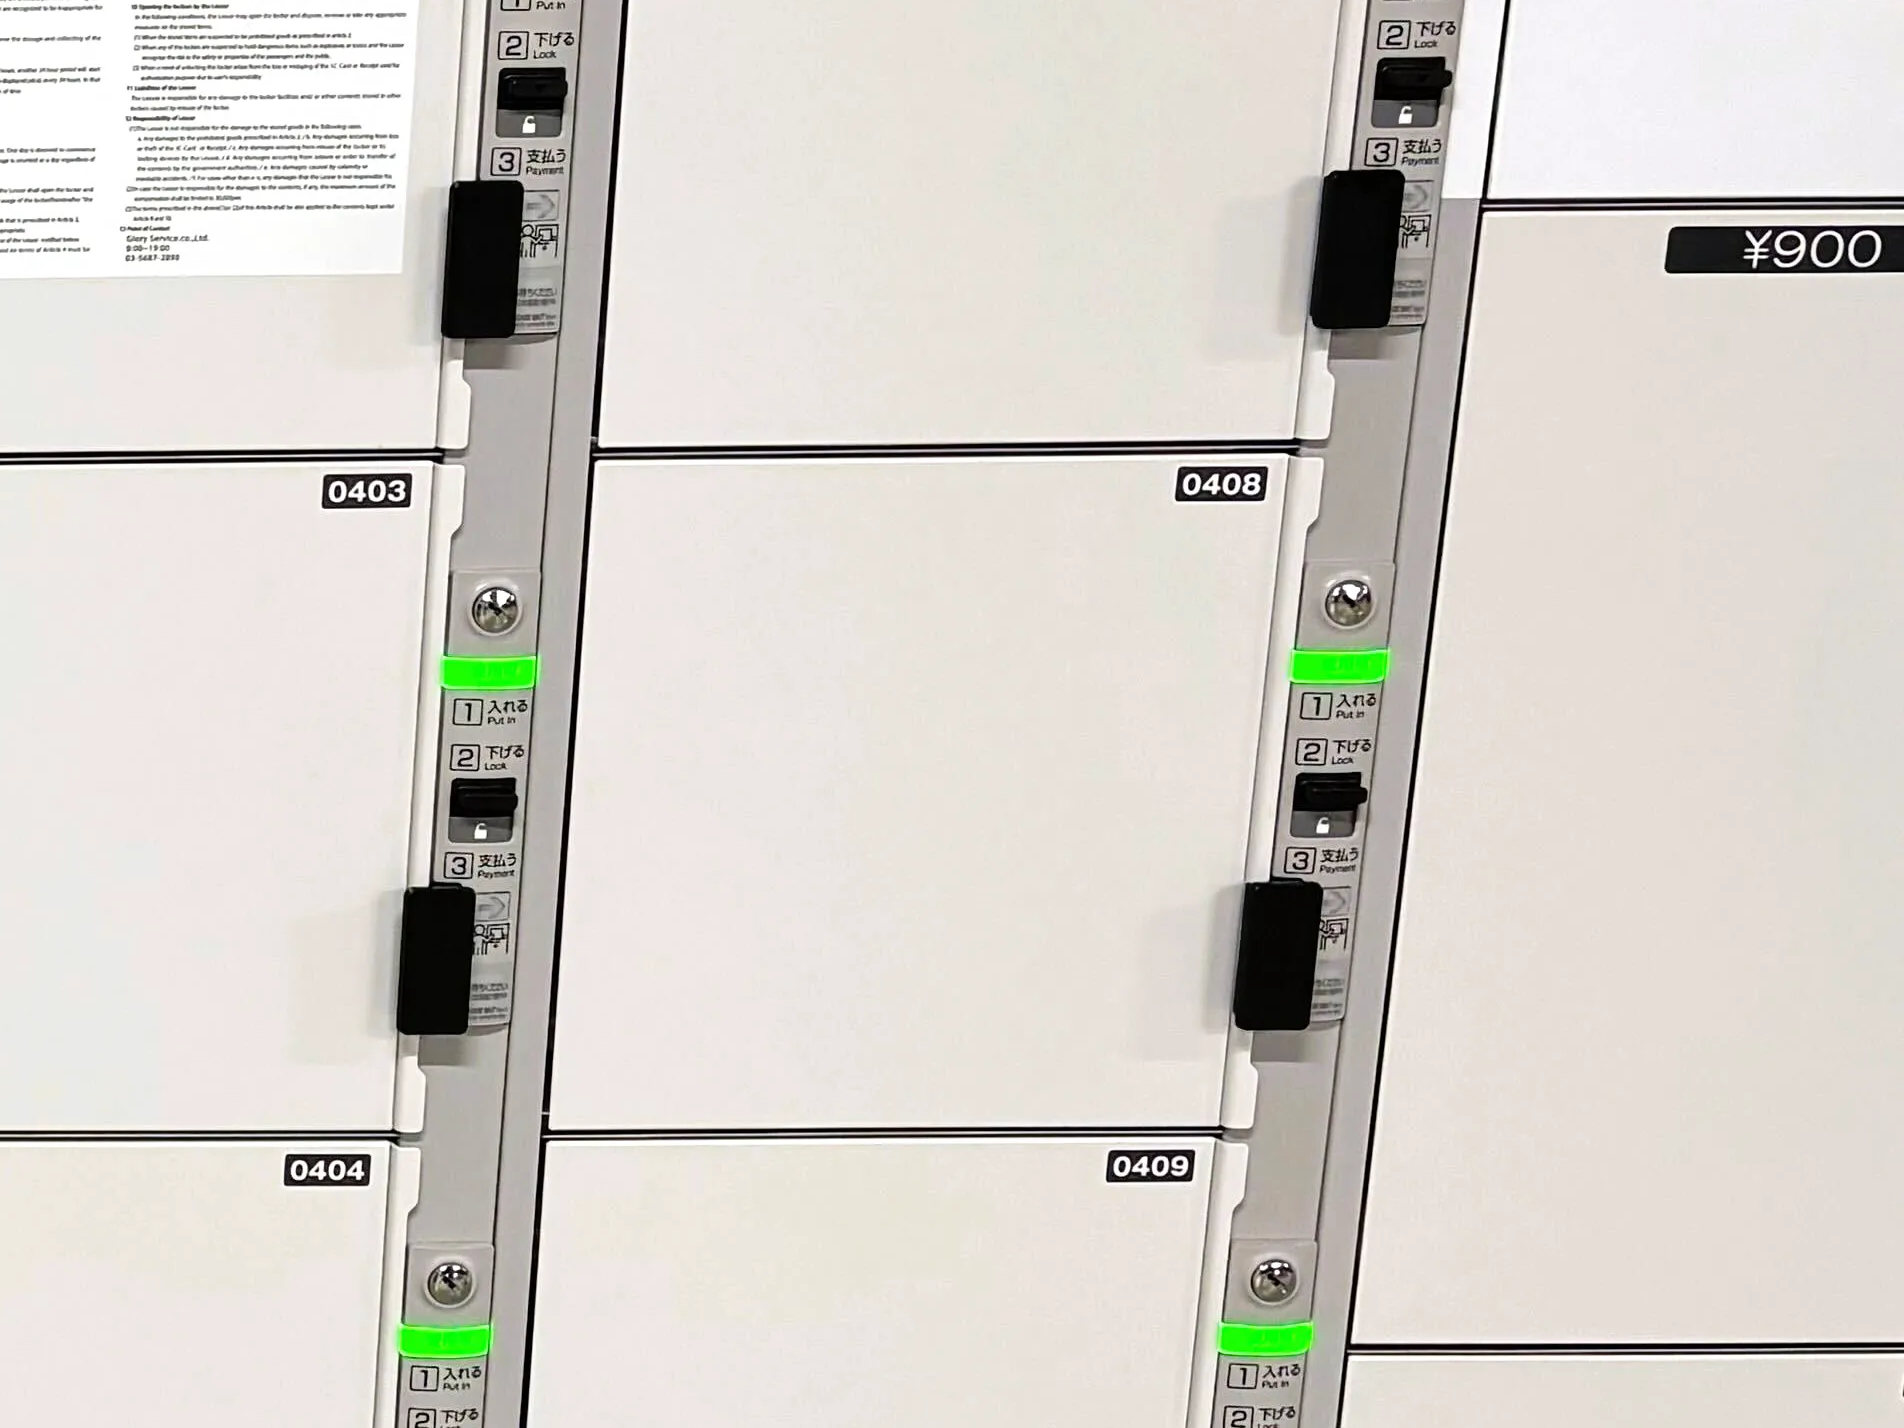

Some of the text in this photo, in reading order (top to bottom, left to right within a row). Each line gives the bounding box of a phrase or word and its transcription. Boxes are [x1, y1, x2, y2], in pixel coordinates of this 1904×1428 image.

[1743, 229, 1882, 269] ¥900
[328, 479, 406, 503] 0403
[1182, 472, 1261, 496] 0408
[290, 1159, 365, 1181] 0404
[1113, 1155, 1189, 1178] 0409
